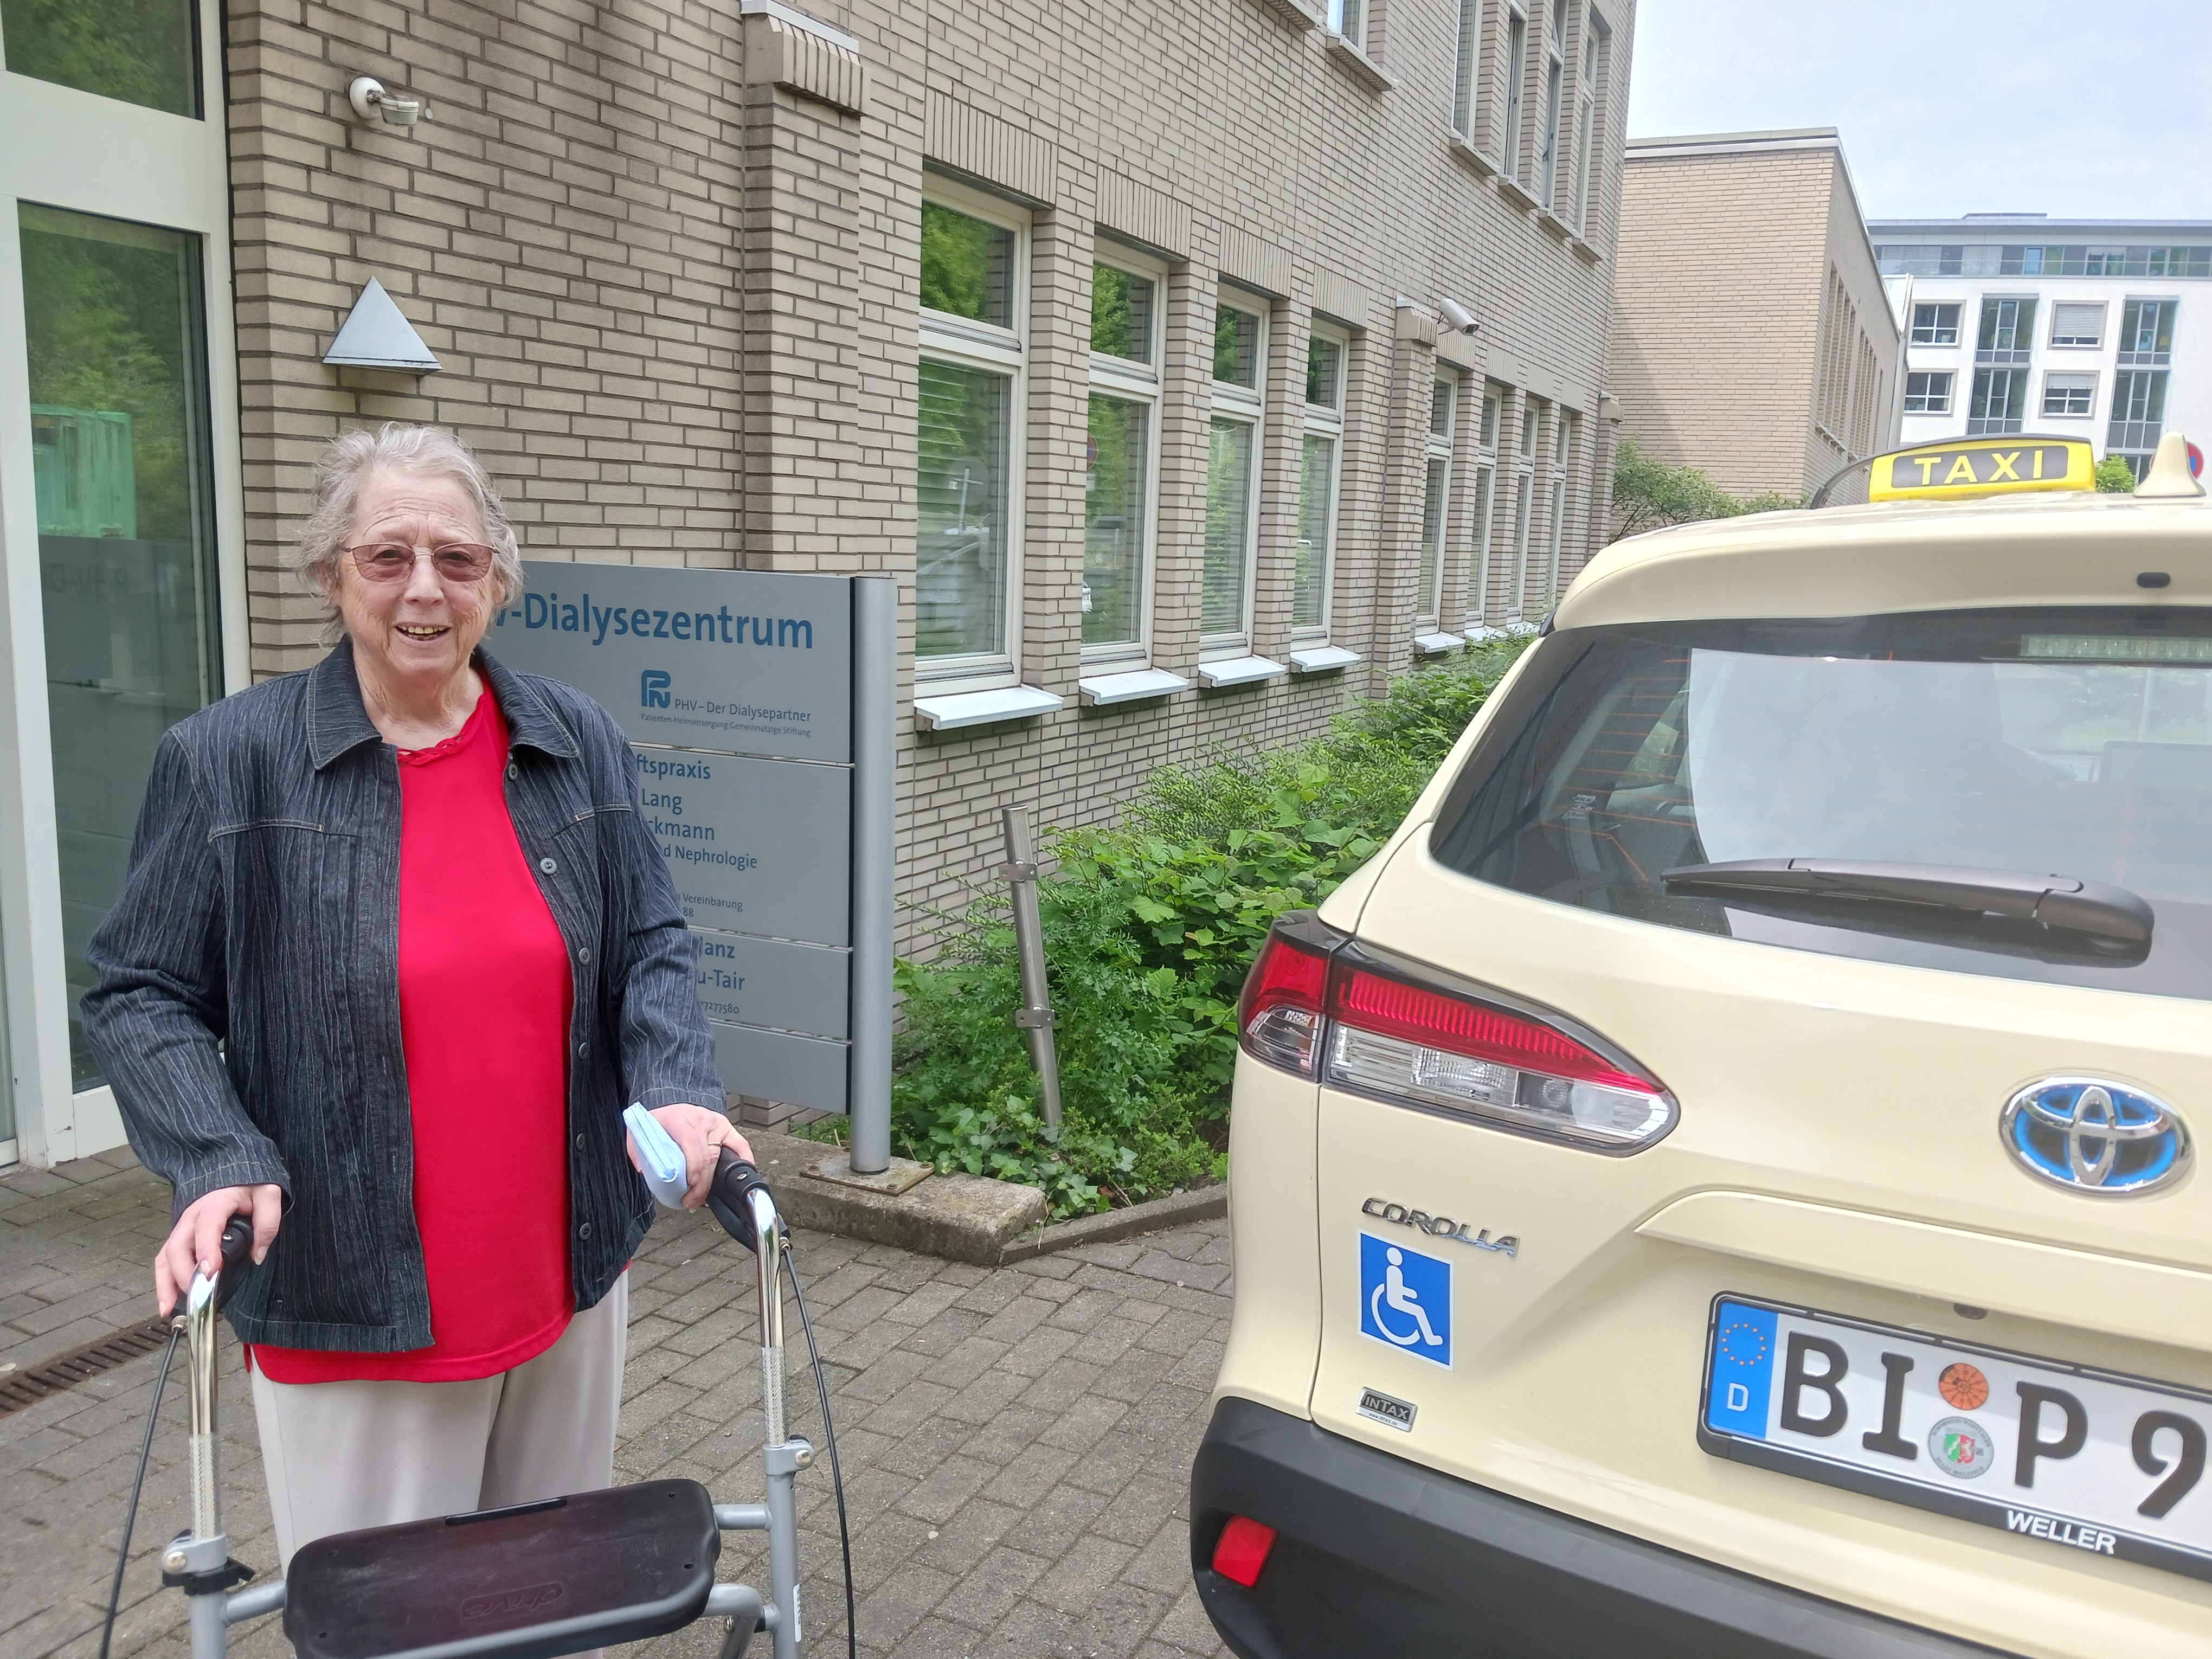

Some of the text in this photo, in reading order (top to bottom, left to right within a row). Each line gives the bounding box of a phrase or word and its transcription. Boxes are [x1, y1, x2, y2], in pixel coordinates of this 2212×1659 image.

[1914, 449, 2043, 485] TAXI
[707, 702, 726, 714] Der
[730, 704, 811, 722] Dialysepartner
[641, 713, 811, 738] Patienten-Heimversorgung Gemeinnützige Stiftung
[642, 788, 683, 815] Lang
[648, 816, 715, 841] kmann
[676, 845, 757, 871] Nephrologie
[683, 892, 743, 912] Vereinbarung
[1361, 1196, 1521, 1258] COROLLA
[1365, 1396, 1409, 1420] INTAX
[1727, 1382, 1749, 1412] D
[1780, 1330, 1919, 1461] BI
[2008, 1510, 2117, 1555] WELLER
